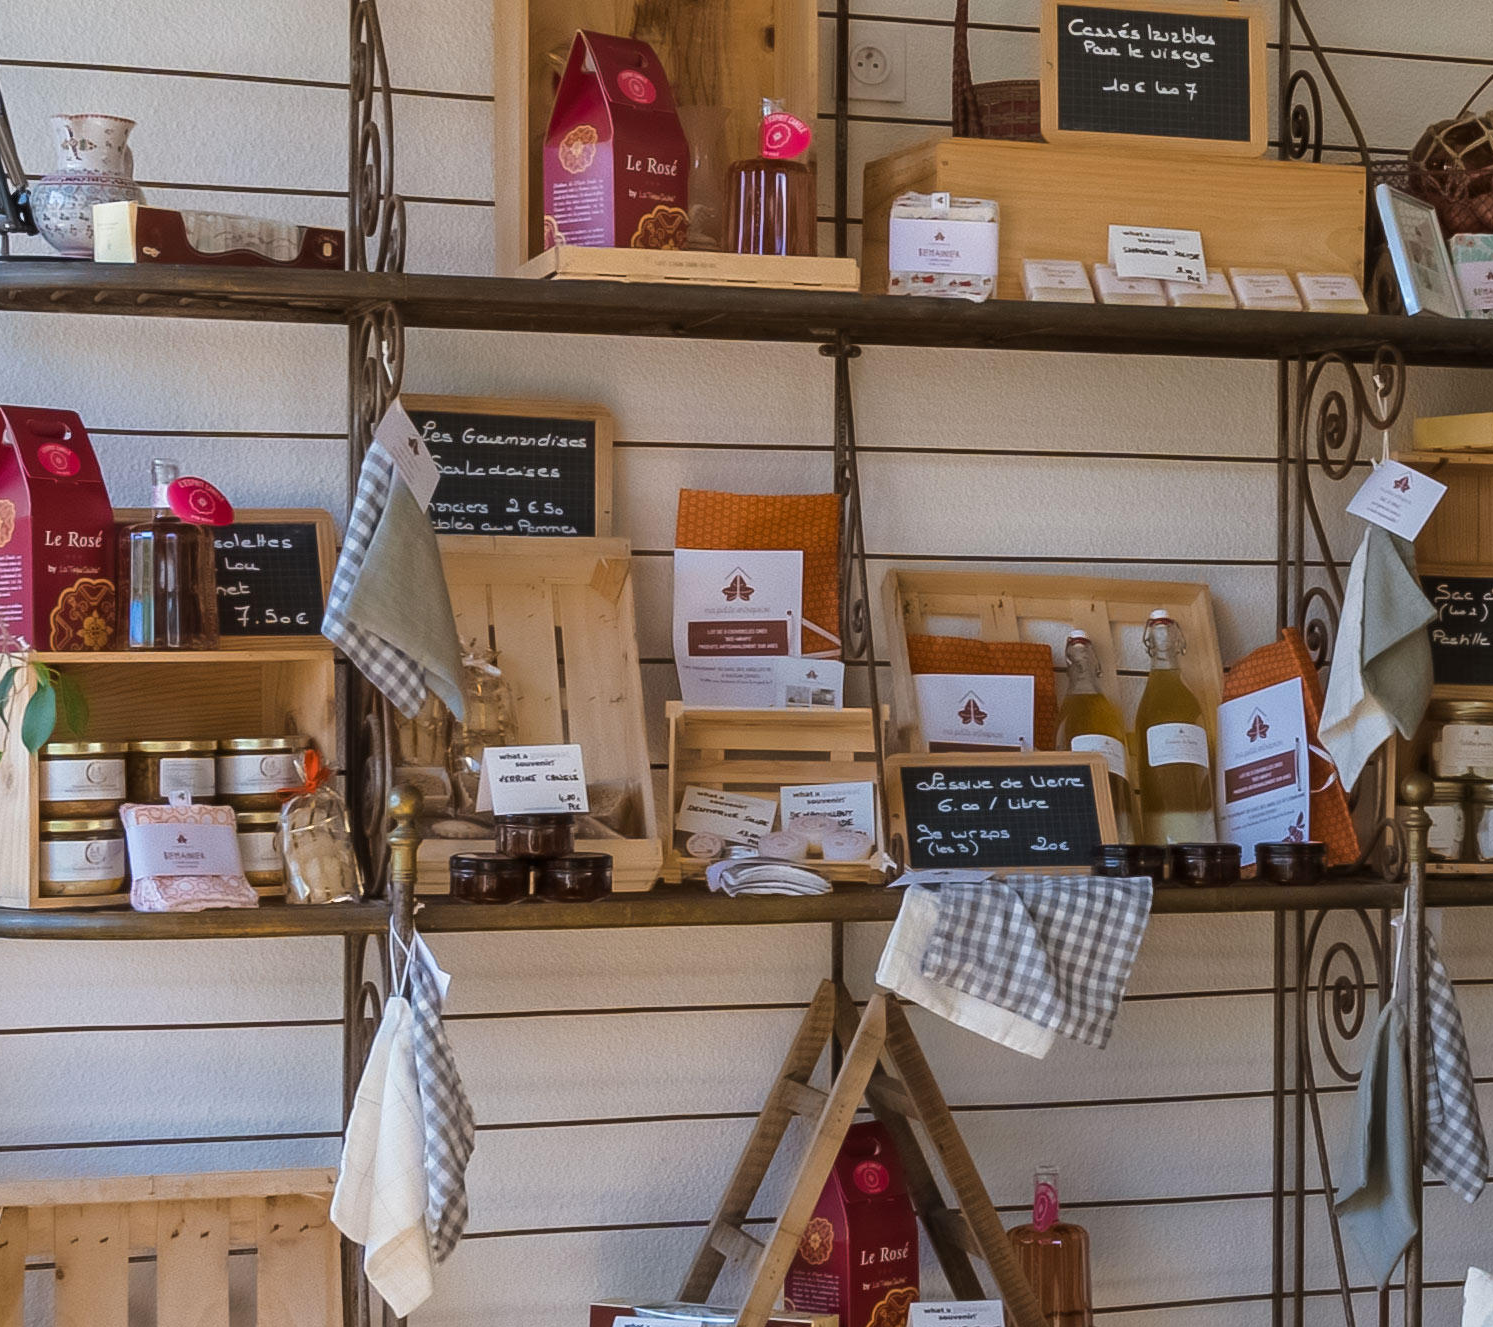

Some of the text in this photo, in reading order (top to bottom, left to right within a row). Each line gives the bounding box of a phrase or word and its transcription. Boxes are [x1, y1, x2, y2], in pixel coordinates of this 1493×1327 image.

[1185, 83, 1198, 102] 7
[626, 154, 678, 177] Le Rosé
[423, 420, 453, 443] Les
[44, 530, 103, 549] Le Rosé
[1000, 778, 1023, 788] de
[861, 1242, 909, 1266] Le Rosé
